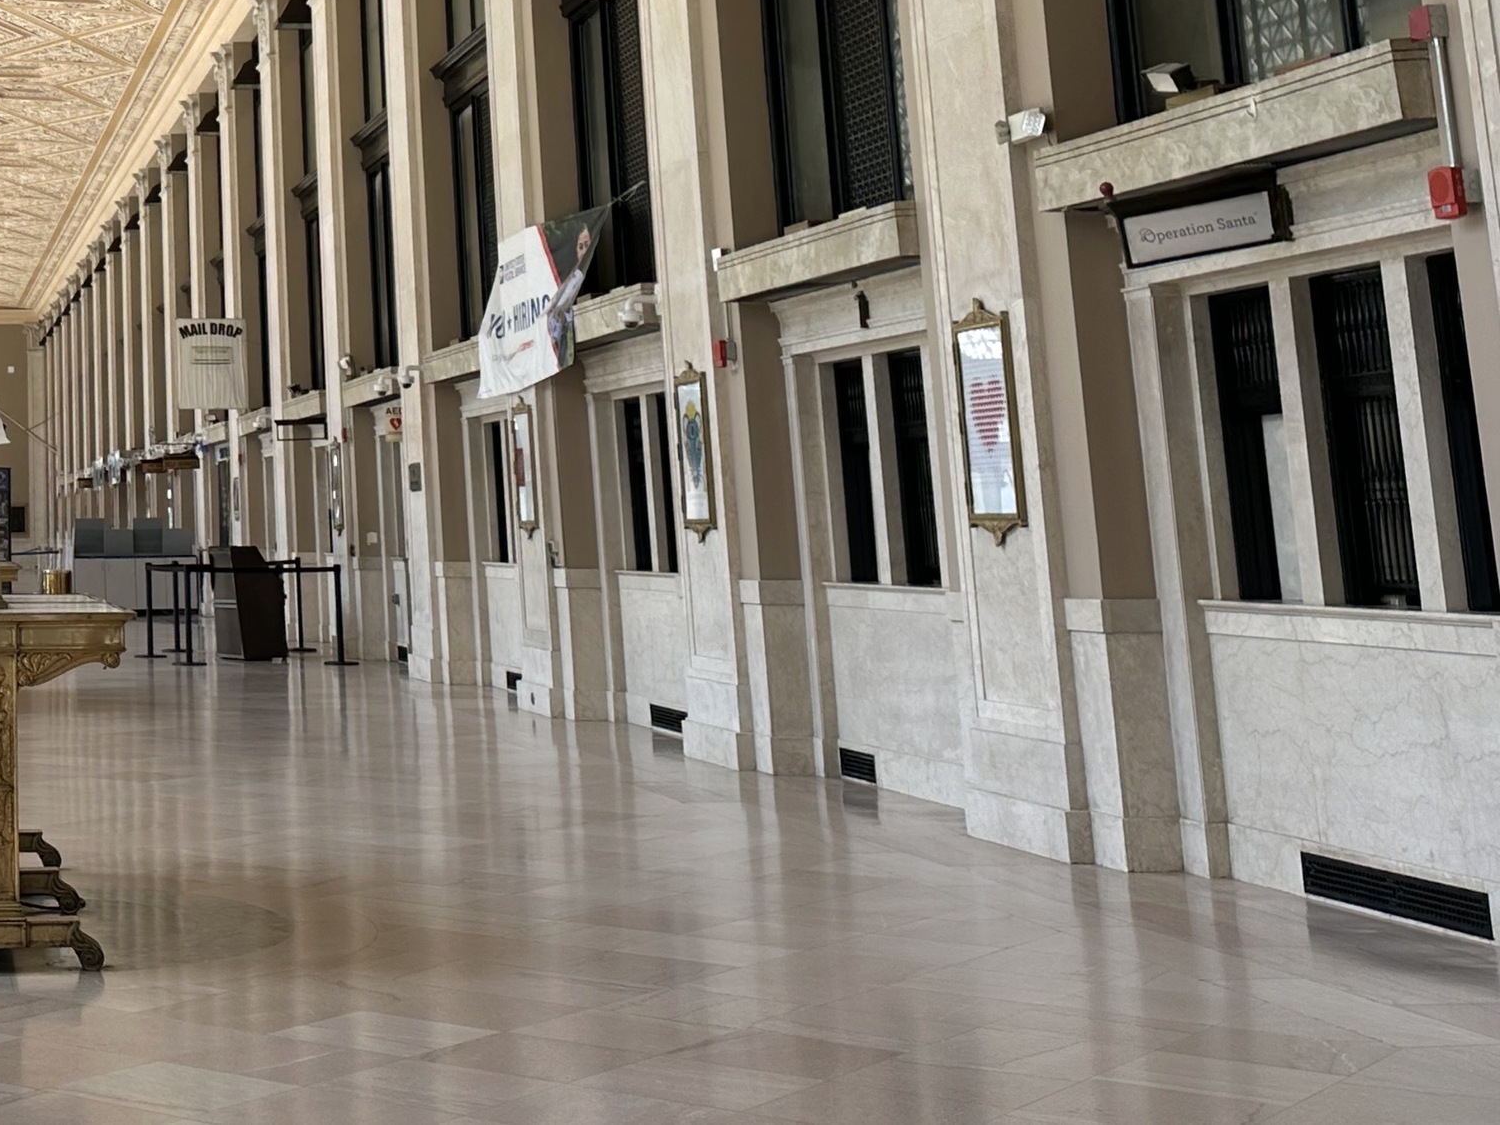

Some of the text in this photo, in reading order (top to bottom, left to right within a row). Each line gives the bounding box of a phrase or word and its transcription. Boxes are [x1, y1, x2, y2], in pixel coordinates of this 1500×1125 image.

[1139, 214, 1257, 244] Operation Santa
[179, 322, 243, 339] MAIL DROP
